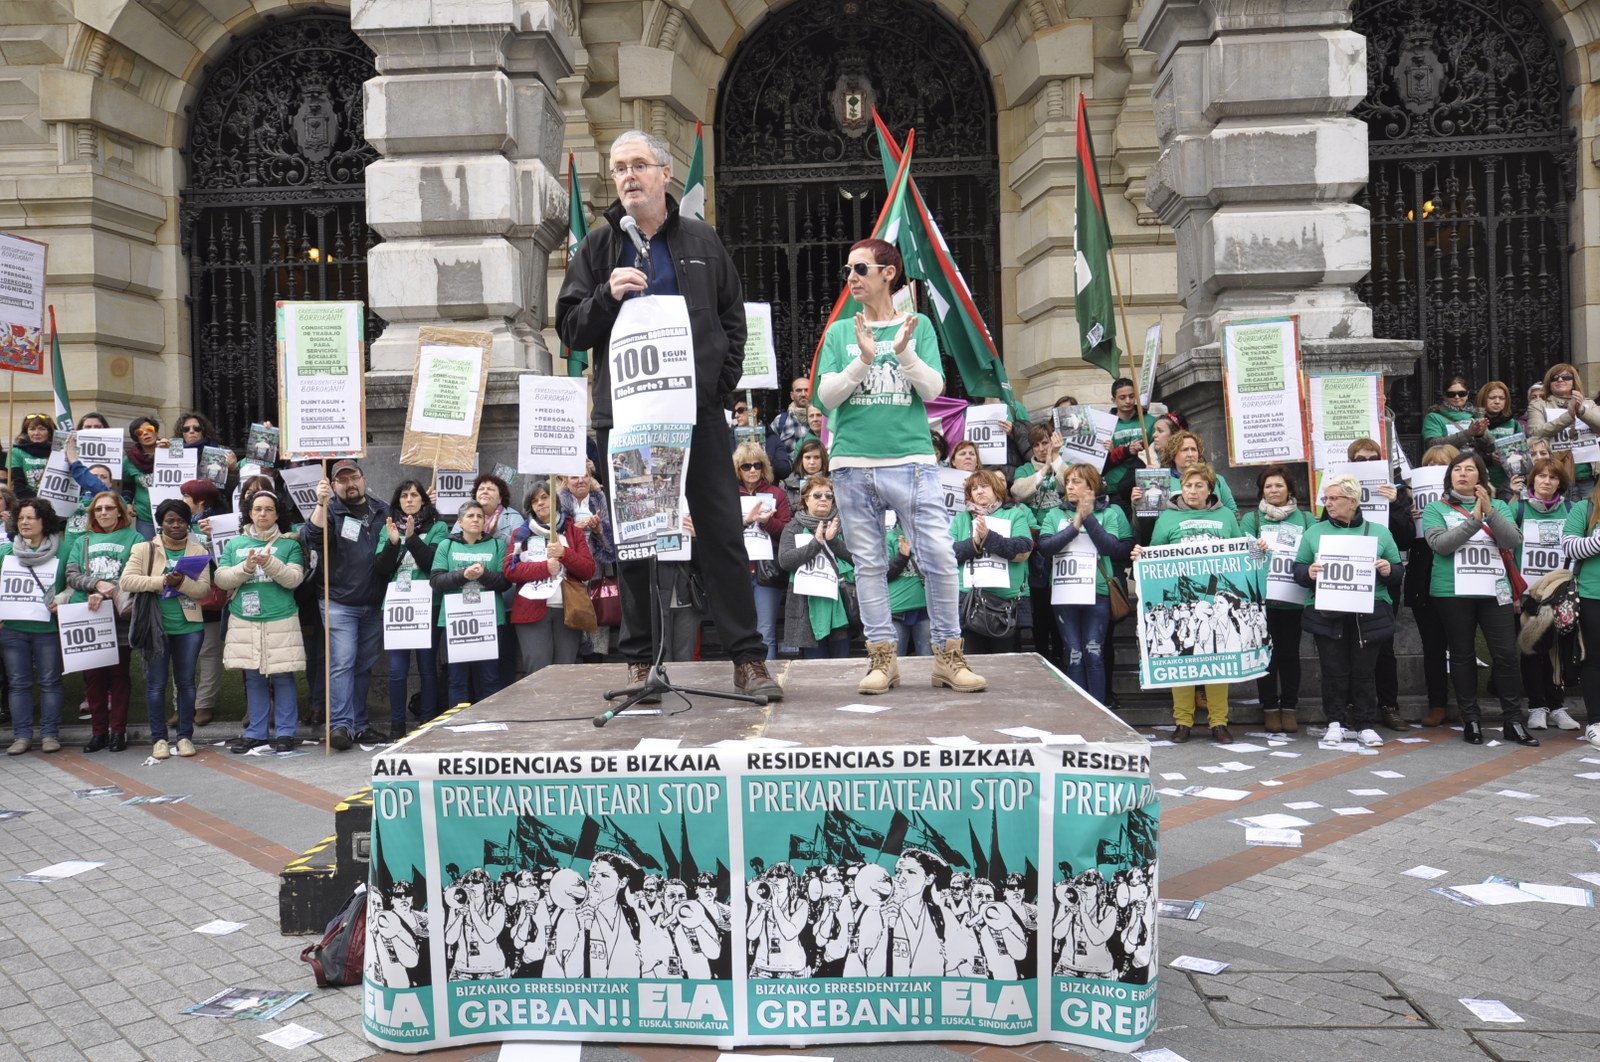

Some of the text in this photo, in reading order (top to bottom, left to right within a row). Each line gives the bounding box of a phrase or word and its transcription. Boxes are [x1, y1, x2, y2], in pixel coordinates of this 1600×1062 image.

[613, 345, 660, 383] 100
[617, 377, 688, 398] Noiz arte? ELA
[663, 423, 690, 431] BIZKAIA
[967, 426, 991, 442] 100
[1243, 431, 1286, 439] EMAKUMEAK
[534, 432, 575, 440] DIGNIDAD
[671, 433, 690, 444] STOP
[1247, 436, 1283, 445] GARELAKO
[79, 442, 106, 456] 100
[560, 446, 577, 455] ELA
[45, 474, 70, 493] 100
[157, 469, 182, 483] 100
[438, 475, 463, 490] 100
[293, 489, 317, 504] 100
[656, 535, 681, 550] ELA
[1141, 546, 1208, 560] RESIDENCIAS
[1212, 543, 1225, 554] DE
[1458, 547, 1491, 566] 100
[1526, 550, 1559, 569] 100
[1055, 558, 1078, 576] 100
[1142, 556, 1241, 580] PREKARIETATEARI
[1267, 557, 1293, 575] 00
[1321, 562, 1354, 582] 100
[3, 578, 34, 594] 100
[387, 606, 415, 622] 100
[449, 618, 479, 636] 100
[63, 627, 96, 646] 100
[1152, 654, 1237, 666] BIZKAIKO ERRESIDENTZIAK
[1153, 662, 1239, 681] GREBAN!!
[1241, 648, 1269, 671] ELA
[438, 753, 721, 776] RESIDENCIAS DE BIZKAIA
[747, 748, 1036, 770] RESIDENCIAS DE BIZKAIA
[440, 781, 722, 818] PREKARIETATEARI STOP
[748, 778, 1035, 813] PREKARIETATEARI STOP
[455, 982, 630, 998] BIZKAIKO ERRESIDENTZIAK
[755, 980, 933, 996] BIZKAIKO ERRESIDENTZIAK
[1060, 982, 1127, 1000] BIZKAIKO
[365, 981, 430, 1029] ELA
[457, 982, 729, 1028] GREBAN!! ELA
[755, 980, 1033, 1029] GREBAN!! ELA
[380, 1025, 430, 1037] SINDIKATUA
[638, 1019, 729, 1030] EUSKAL SINDIKATUA
[940, 1016, 1033, 1029] EUSKAL SINDIKATUA
